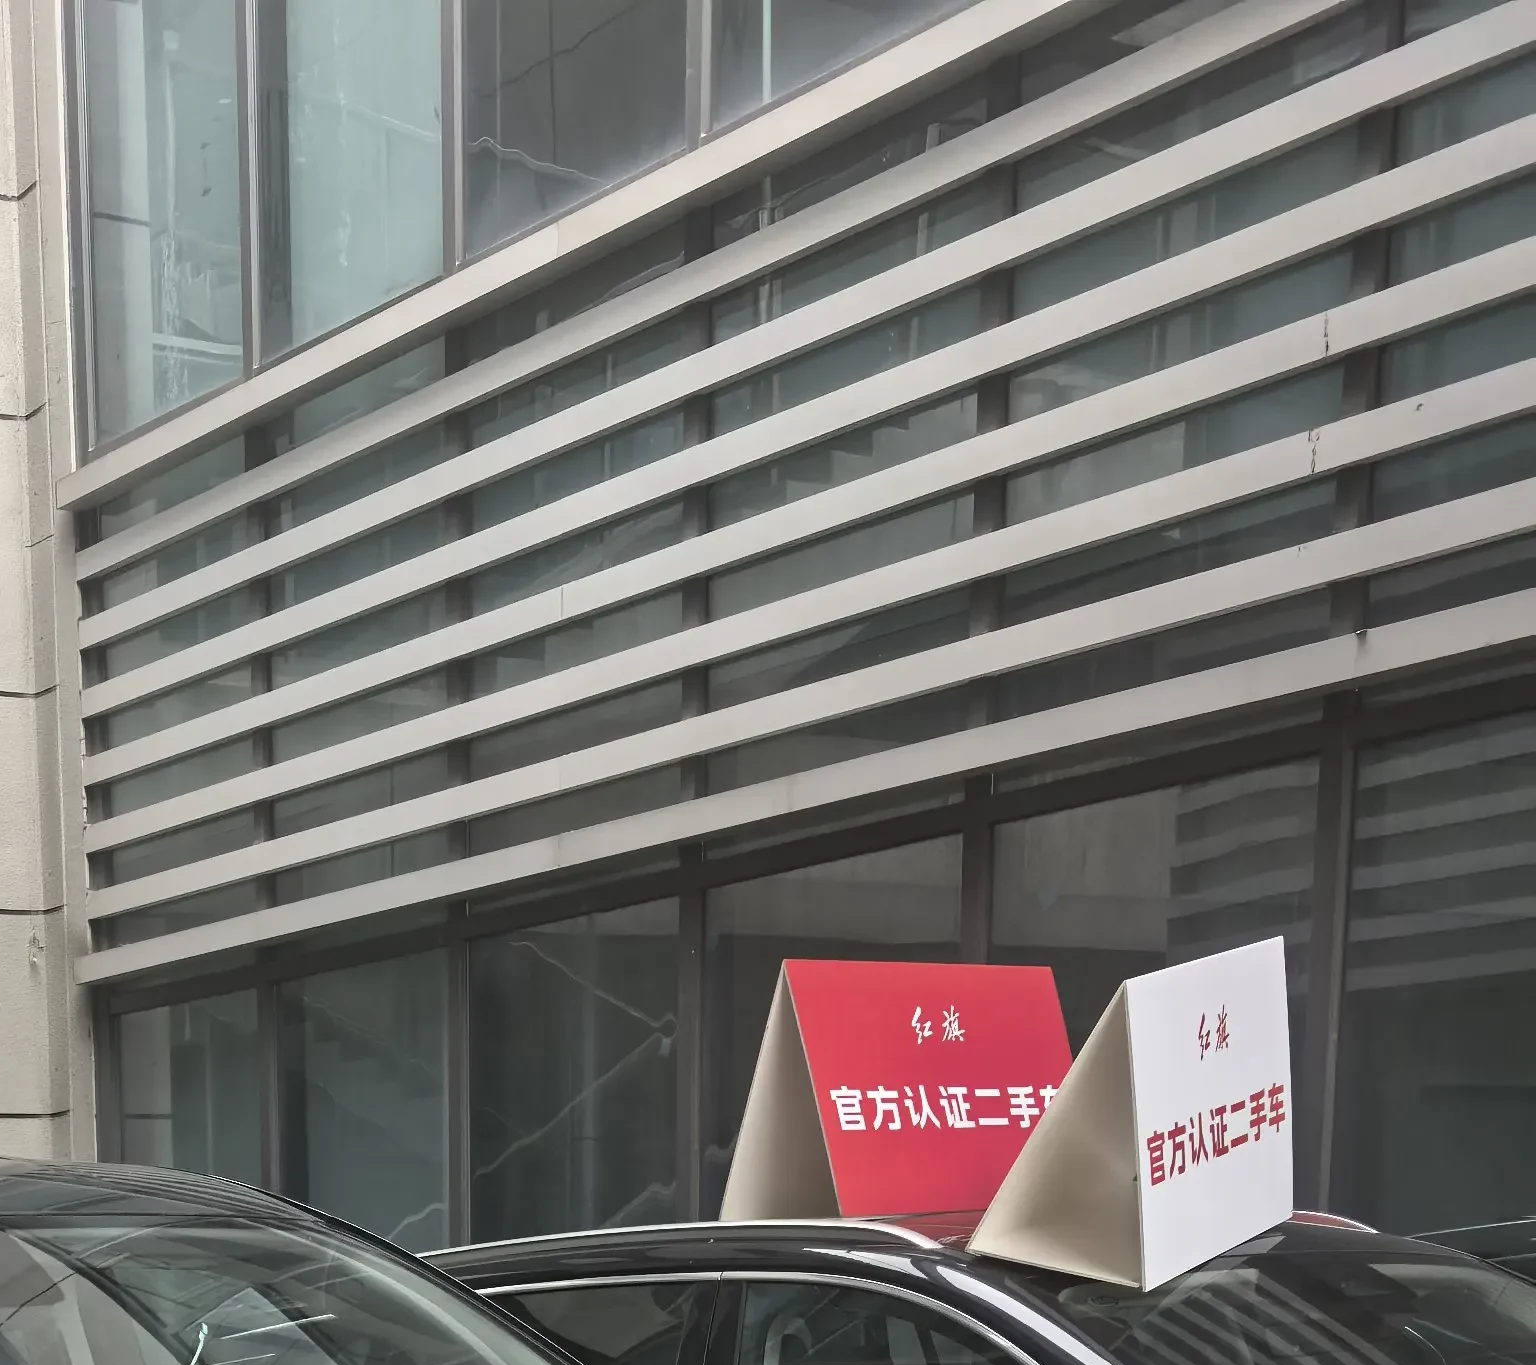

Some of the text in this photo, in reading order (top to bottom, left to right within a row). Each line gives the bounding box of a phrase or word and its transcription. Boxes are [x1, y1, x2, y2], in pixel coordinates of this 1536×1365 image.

[910, 1004, 966, 1045] 红旗
[1197, 1003, 1230, 1061] 红旗
[1146, 1082, 1286, 1187] 官方认证二手车
